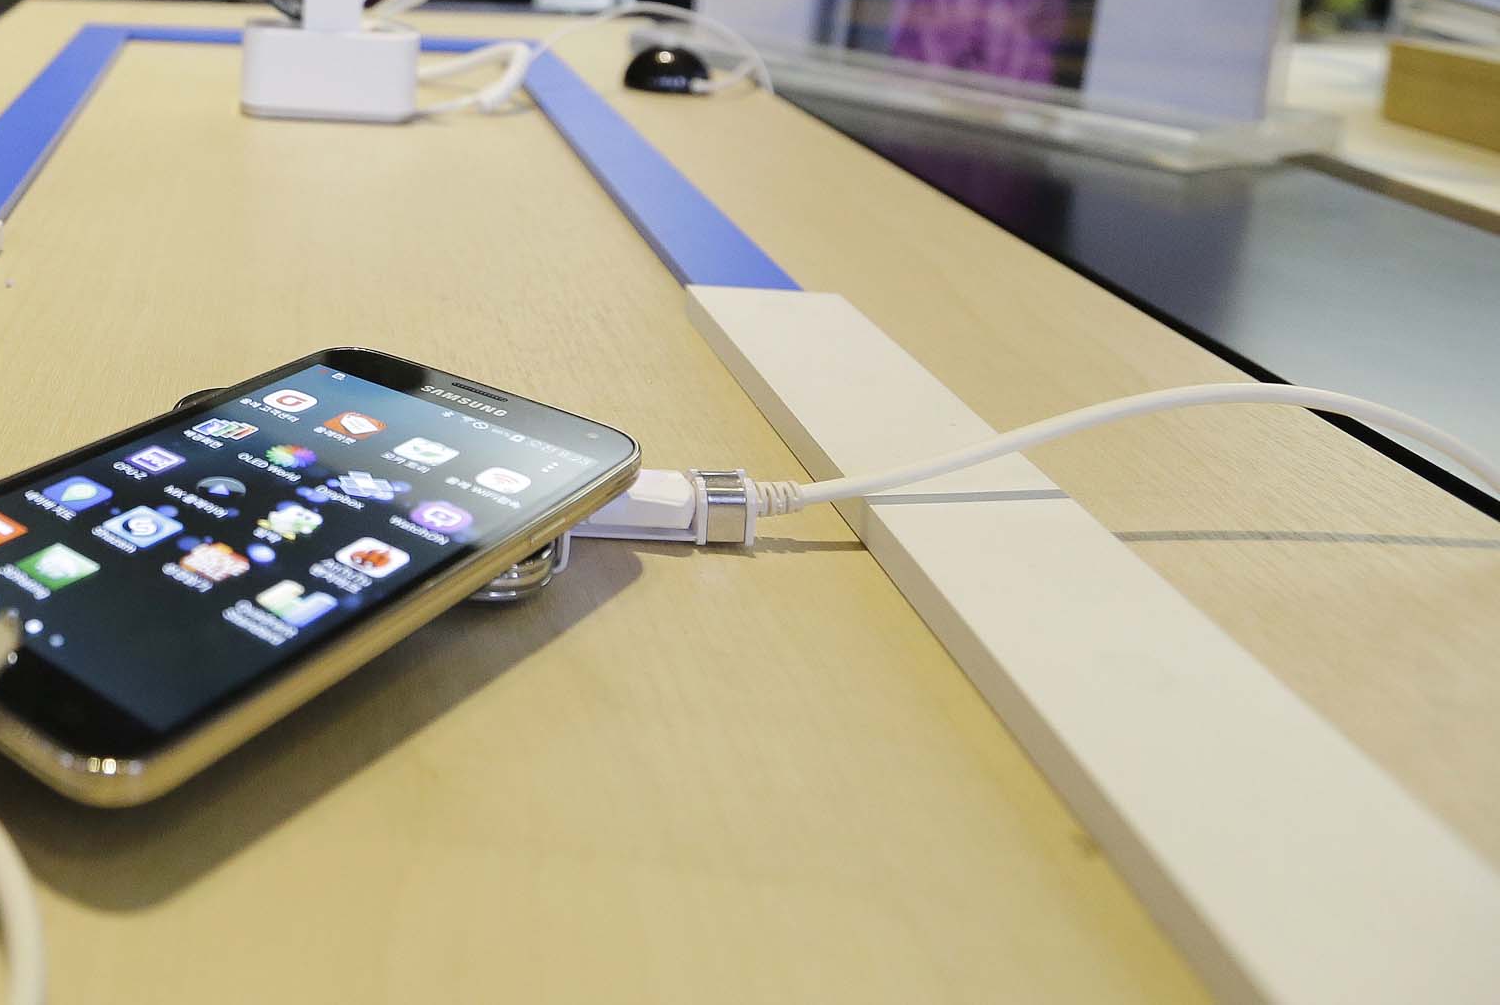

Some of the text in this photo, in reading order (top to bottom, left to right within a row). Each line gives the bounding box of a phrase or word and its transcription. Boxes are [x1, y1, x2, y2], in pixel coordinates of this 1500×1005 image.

[420, 384, 508, 417] SAMSUNG
[237, 452, 270, 470] OLED
[315, 484, 365, 510] Dropbox
